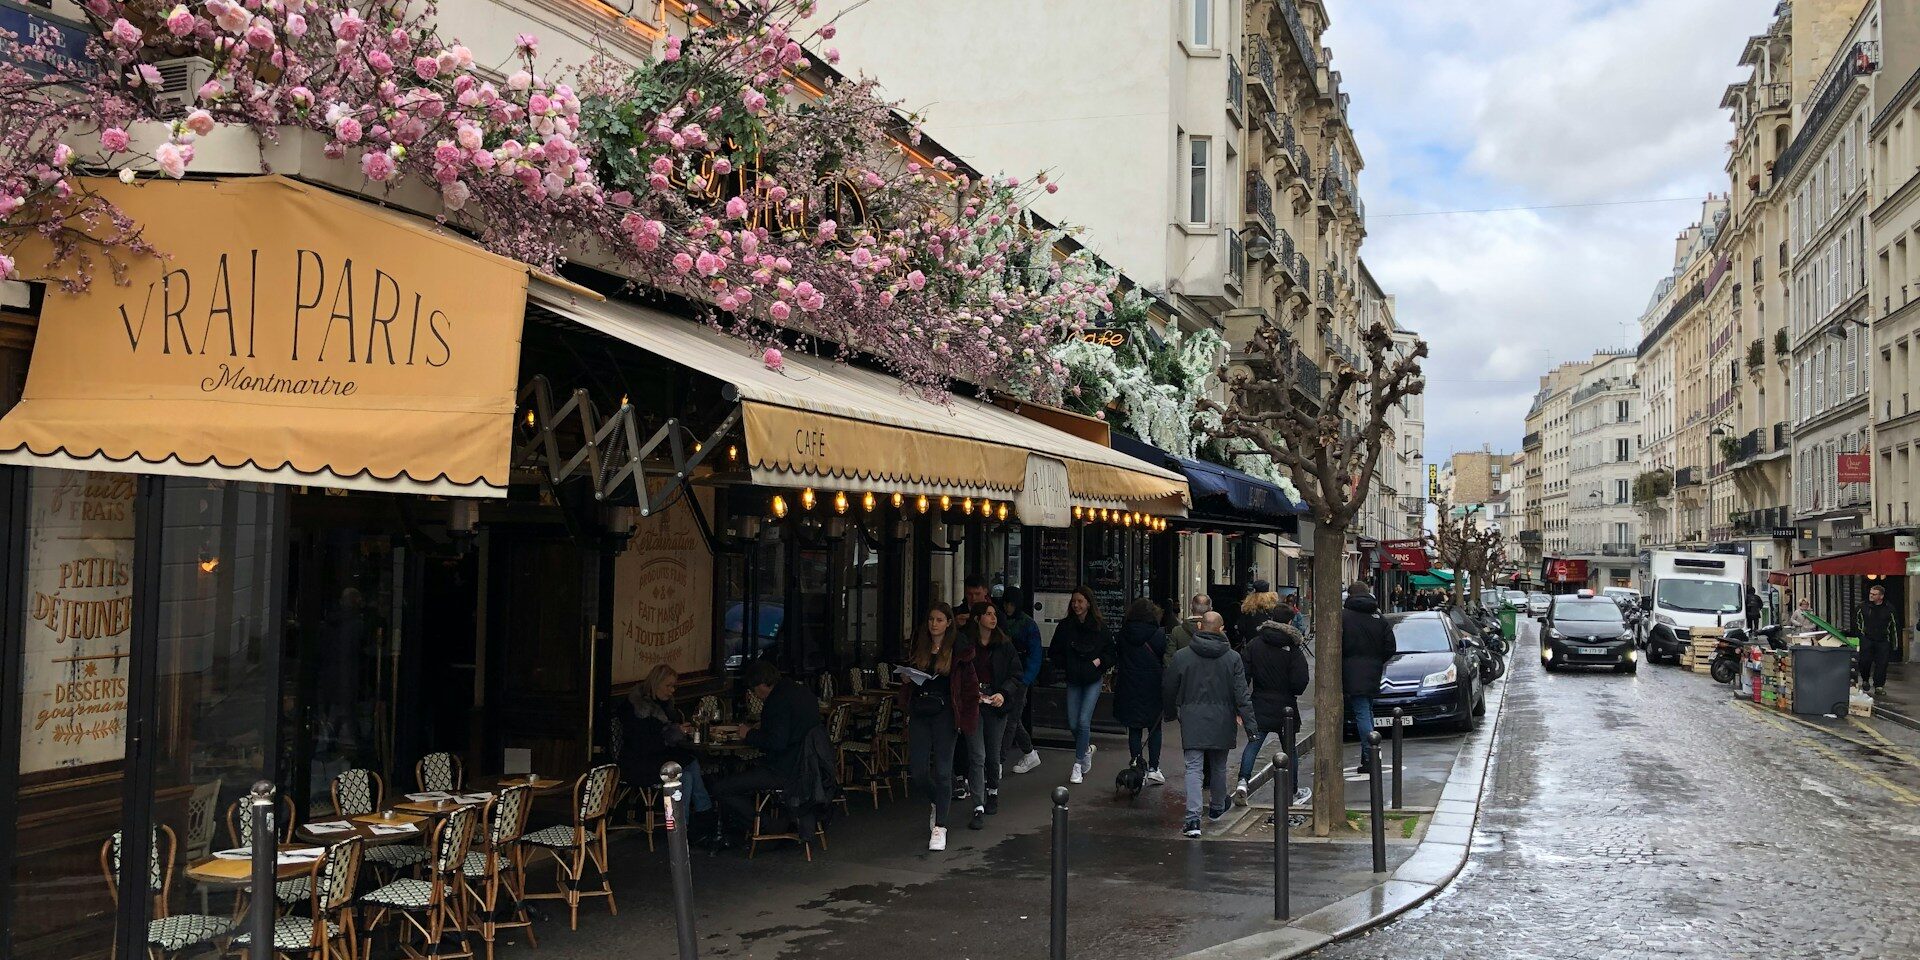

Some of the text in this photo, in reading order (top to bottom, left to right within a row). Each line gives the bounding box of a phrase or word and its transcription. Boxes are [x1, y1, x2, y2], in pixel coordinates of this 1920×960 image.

[118, 249, 451, 367] VRAI PARIS
[201, 363, 358, 396] Montmartre
[795, 428, 825, 457] CAFÉ
[1429, 464, 1437, 496] HOTEL
[69, 500, 125, 521] FRAIS
[59, 558, 129, 589] PETITS
[638, 599, 686, 624] FAIT MAISON
[635, 625, 666, 647] TOUTE
[667, 614, 696, 645] HEURE
[56, 677, 126, 704] DESSERTS
